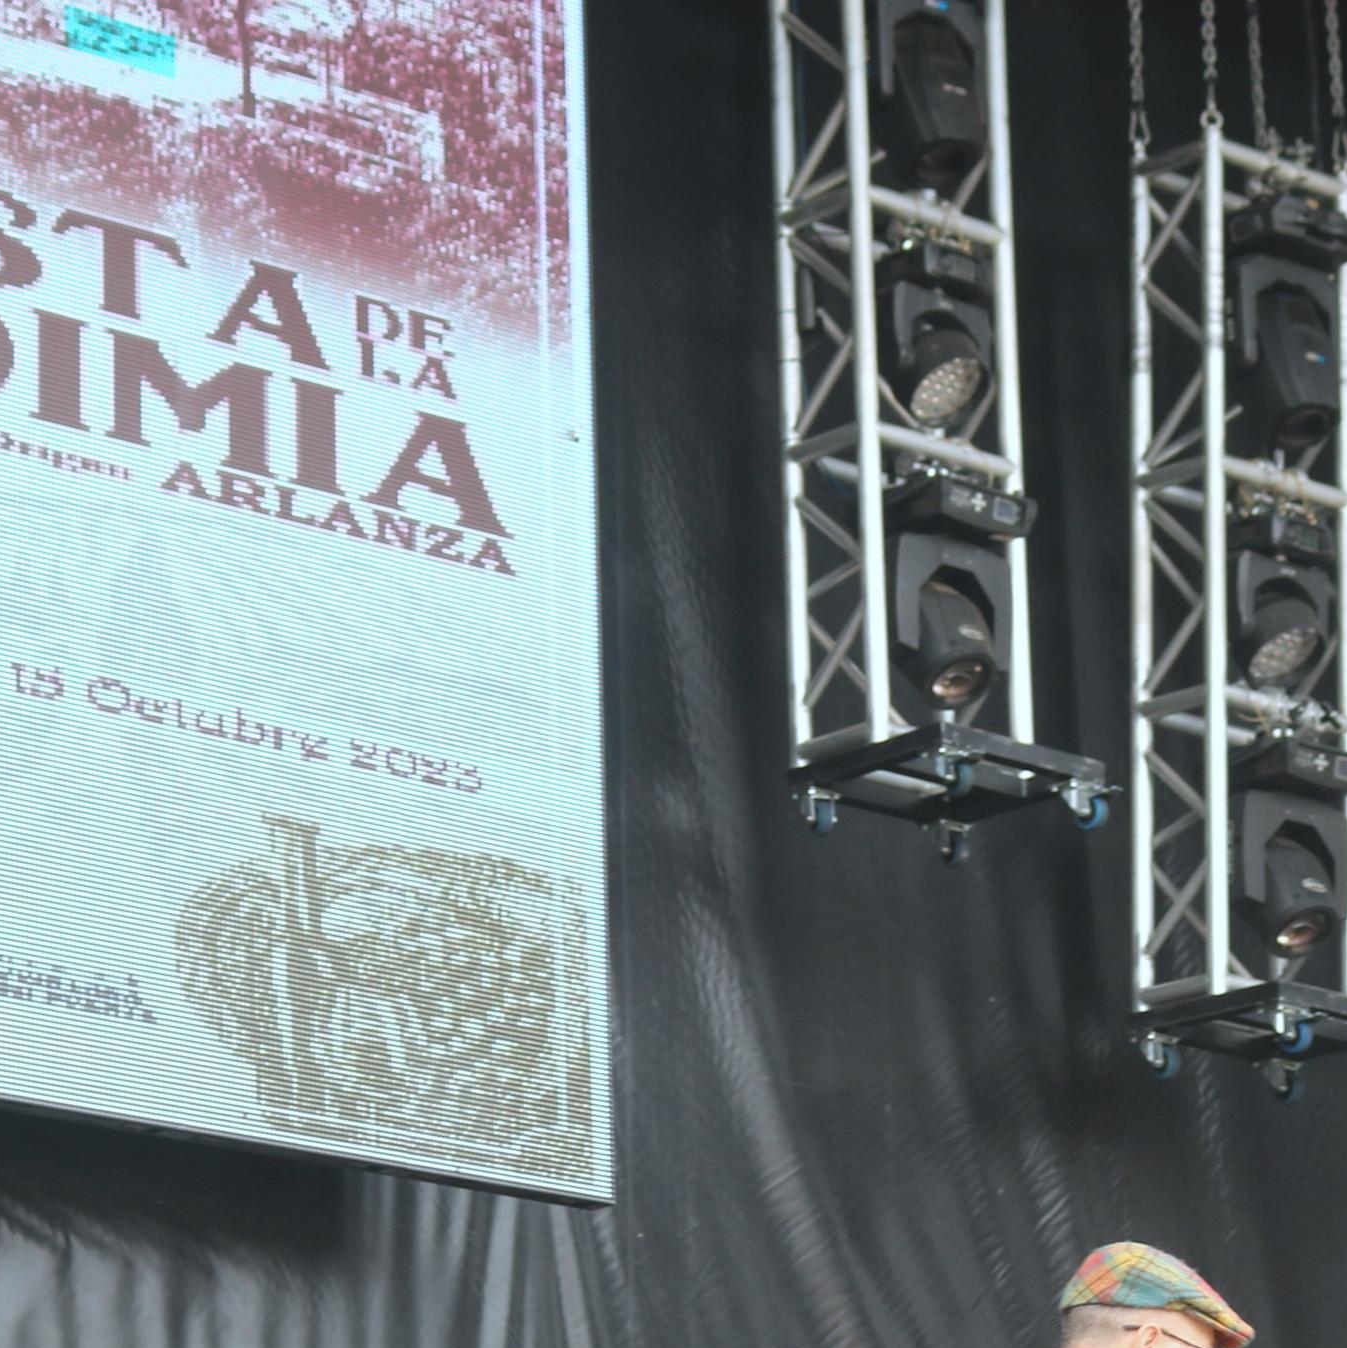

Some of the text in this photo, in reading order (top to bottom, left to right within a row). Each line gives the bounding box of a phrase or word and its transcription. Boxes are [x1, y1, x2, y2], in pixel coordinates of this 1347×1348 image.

[355, 295, 455, 359] DE
[356, 337, 457, 401] LA
[160, 460, 516, 577] ARLANZA
